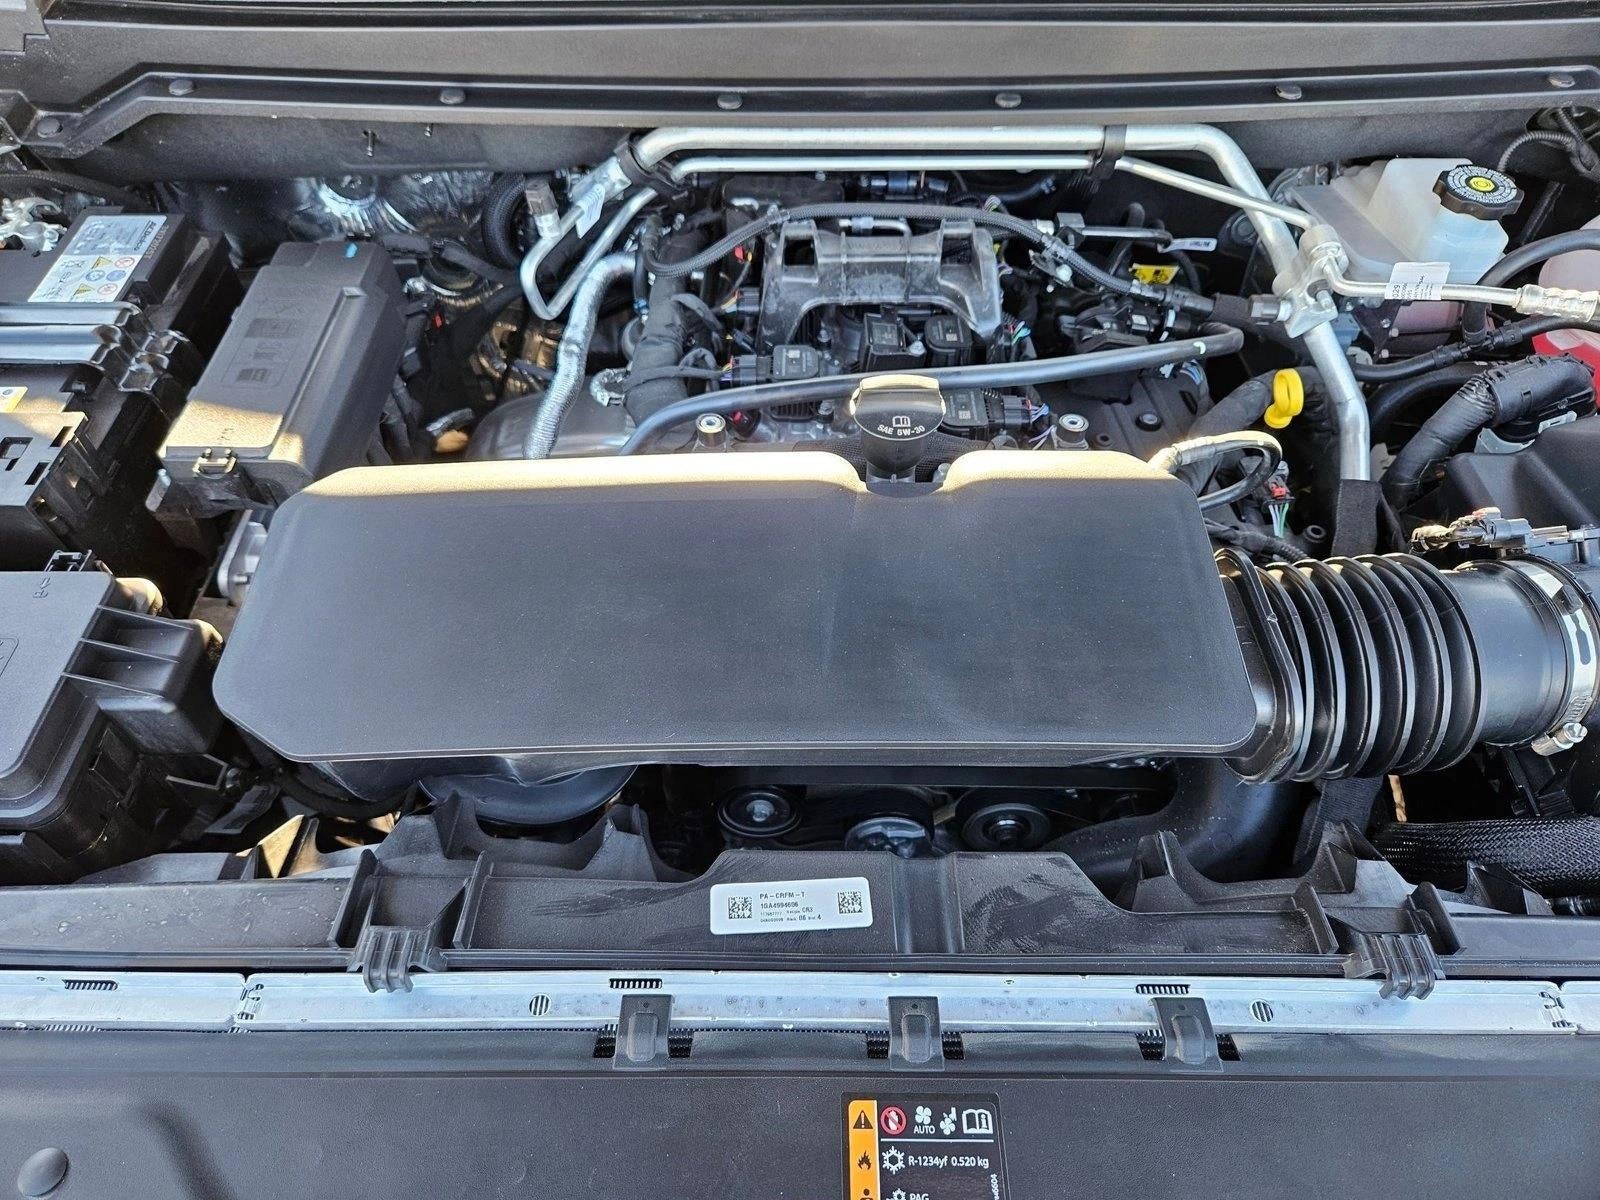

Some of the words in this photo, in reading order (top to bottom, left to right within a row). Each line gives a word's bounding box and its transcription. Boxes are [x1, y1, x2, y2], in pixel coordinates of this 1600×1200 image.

[877, 424, 894, 435] SAE
[913, 1125, 936, 1134] AUTO
[908, 1155, 948, 1169] R-1234yf
[951, 1156, 976, 1167] 0.520
[977, 1155, 990, 1169] kg
